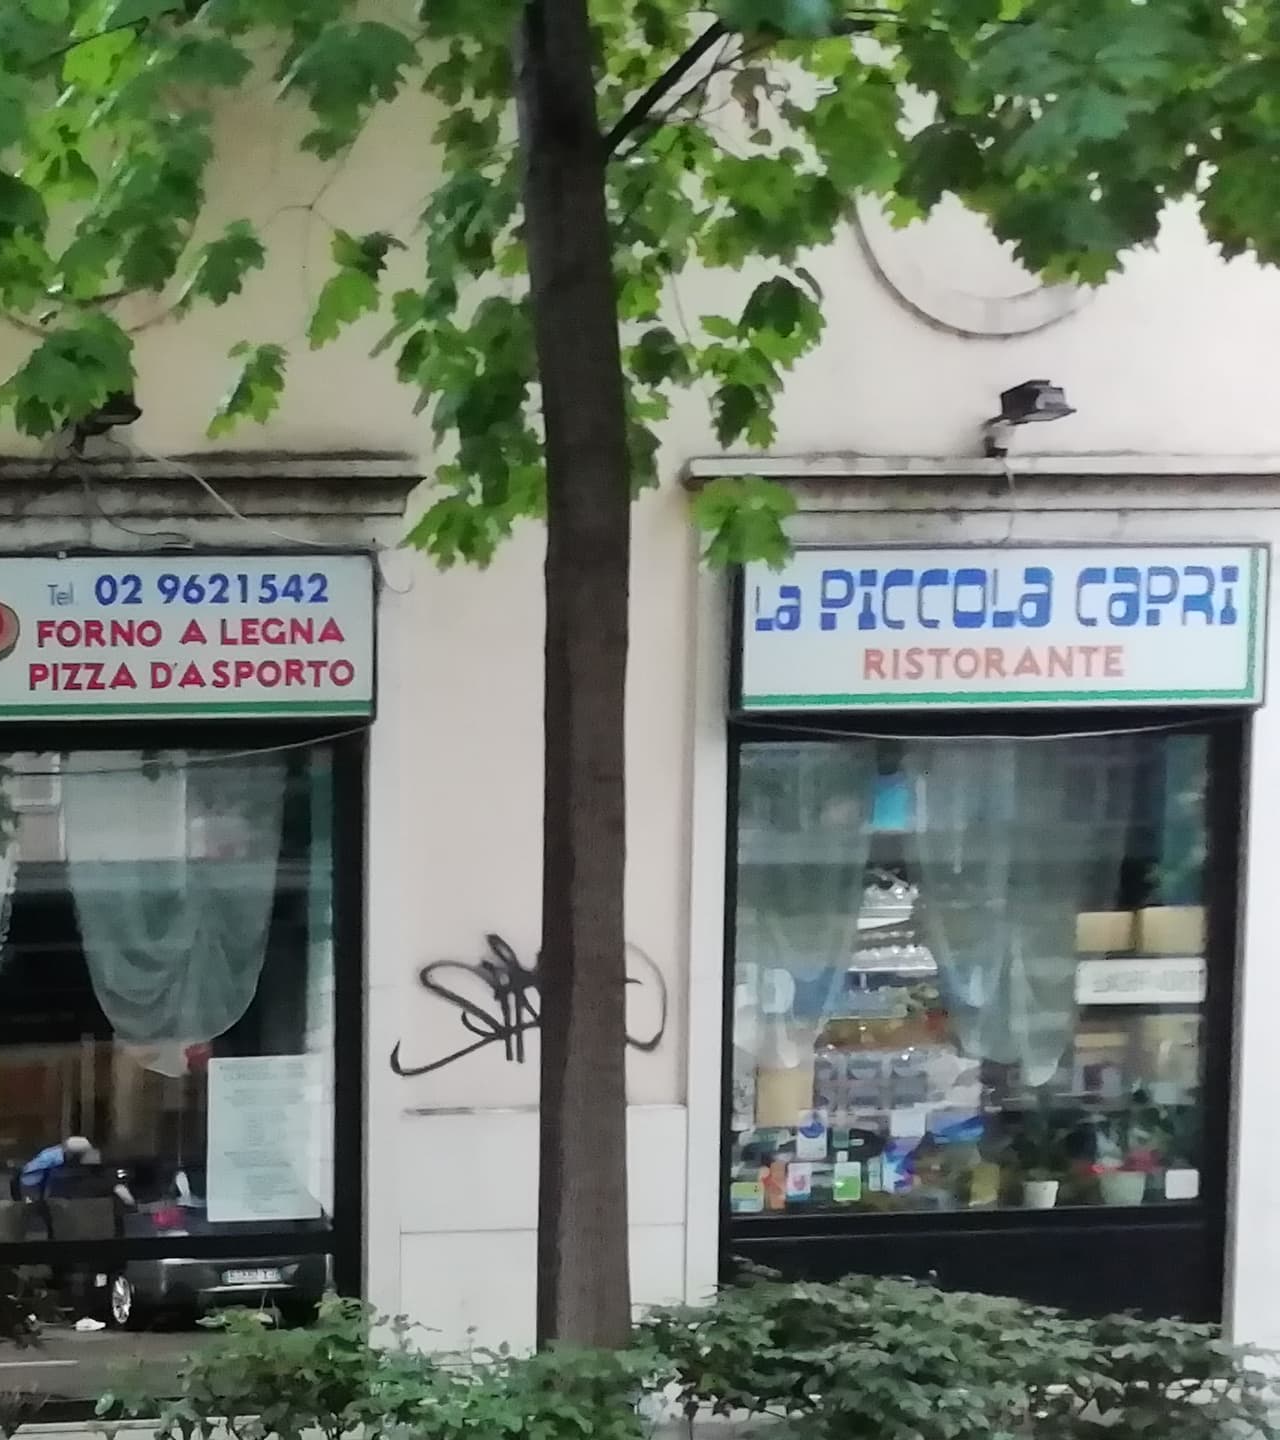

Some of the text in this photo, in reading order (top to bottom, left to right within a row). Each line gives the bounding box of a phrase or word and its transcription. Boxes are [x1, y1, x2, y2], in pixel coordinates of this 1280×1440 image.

[94, 574, 144, 606] 02
[156, 573, 330, 606] 9621542
[37, 618, 345, 648] FORNO A LEGNA
[29, 658, 356, 691] PIZZA D'ASPORTO
[863, 645, 1127, 681] RISTORANTE
